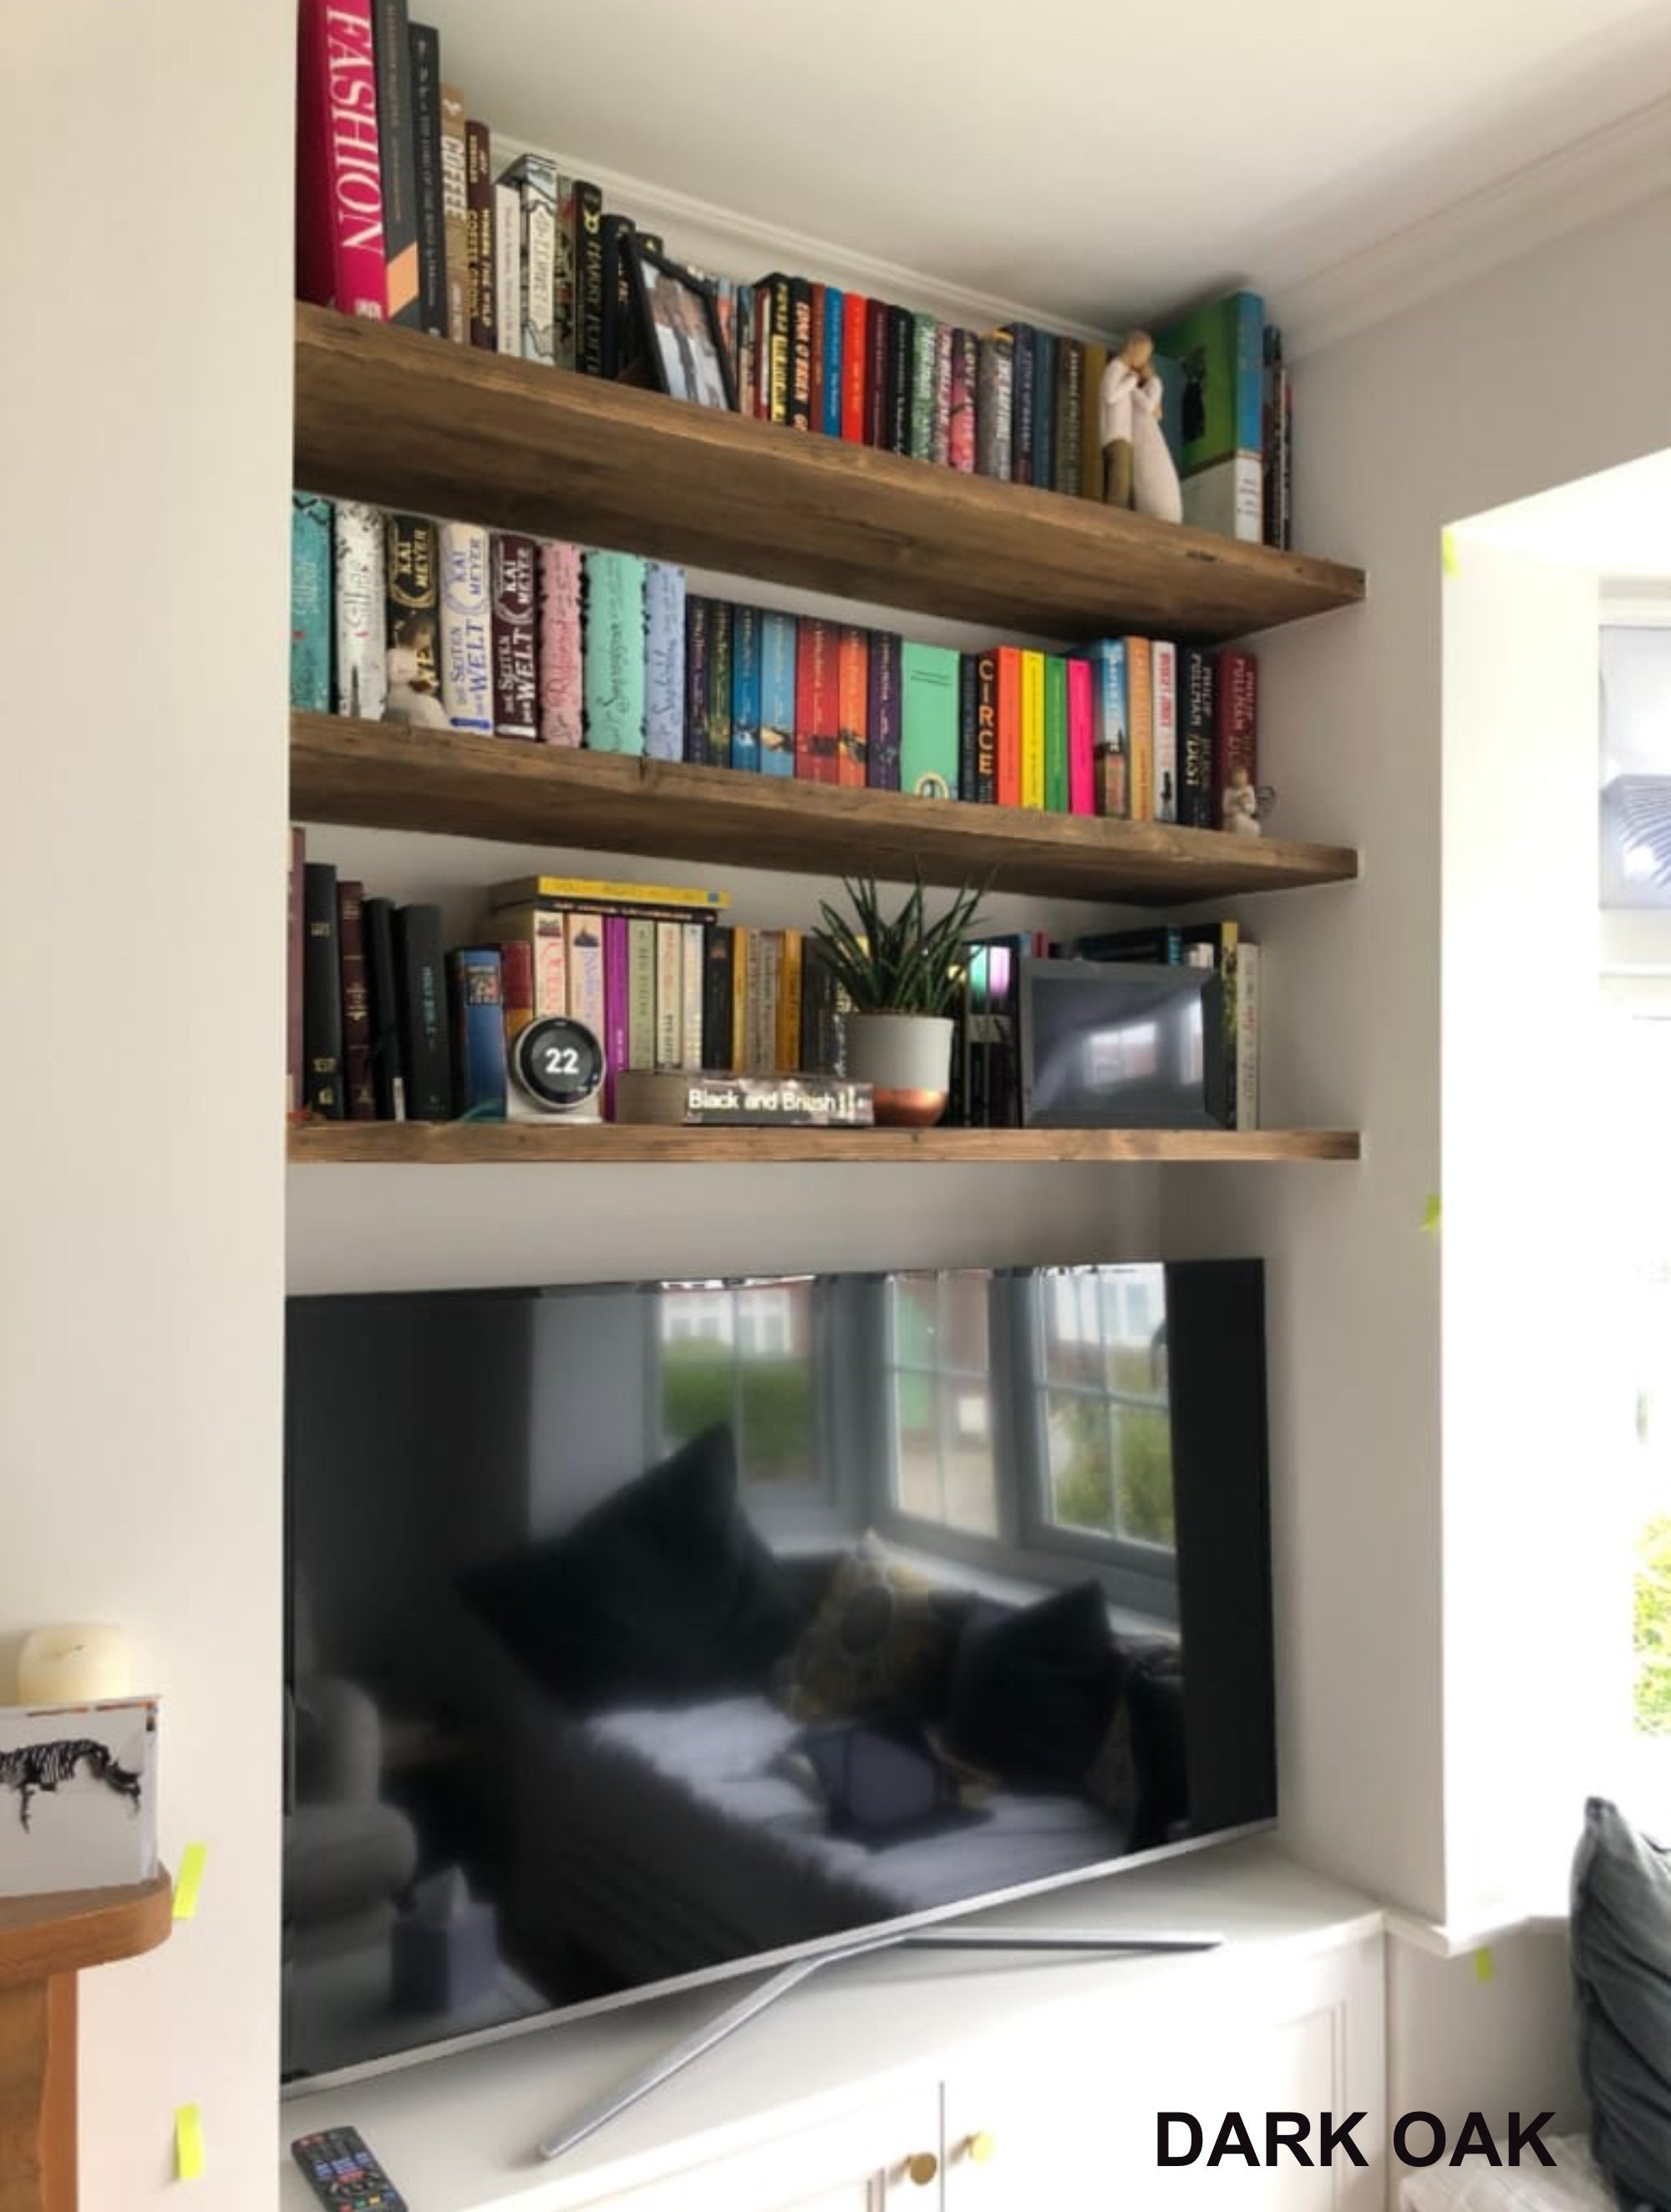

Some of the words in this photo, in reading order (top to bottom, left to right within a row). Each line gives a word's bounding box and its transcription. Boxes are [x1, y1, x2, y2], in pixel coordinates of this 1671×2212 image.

[327, 5, 384, 259] FASHION
[442, 134, 465, 221] COFFEE
[397, 540, 412, 574] KAI
[414, 529, 430, 588] MEYER
[450, 550, 466, 583] KAI
[468, 537, 482, 596] MEYER
[503, 560, 517, 593] KAI
[517, 545, 531, 605] MEYER
[465, 617, 488, 693] WELT
[514, 627, 536, 701] WELT
[978, 659, 995, 774] CIRCE
[545, 1047, 580, 1074] 22
[688, 1088, 739, 1109] Black
[744, 1091, 778, 1110] and
[782, 1089, 836, 1112] Brush
